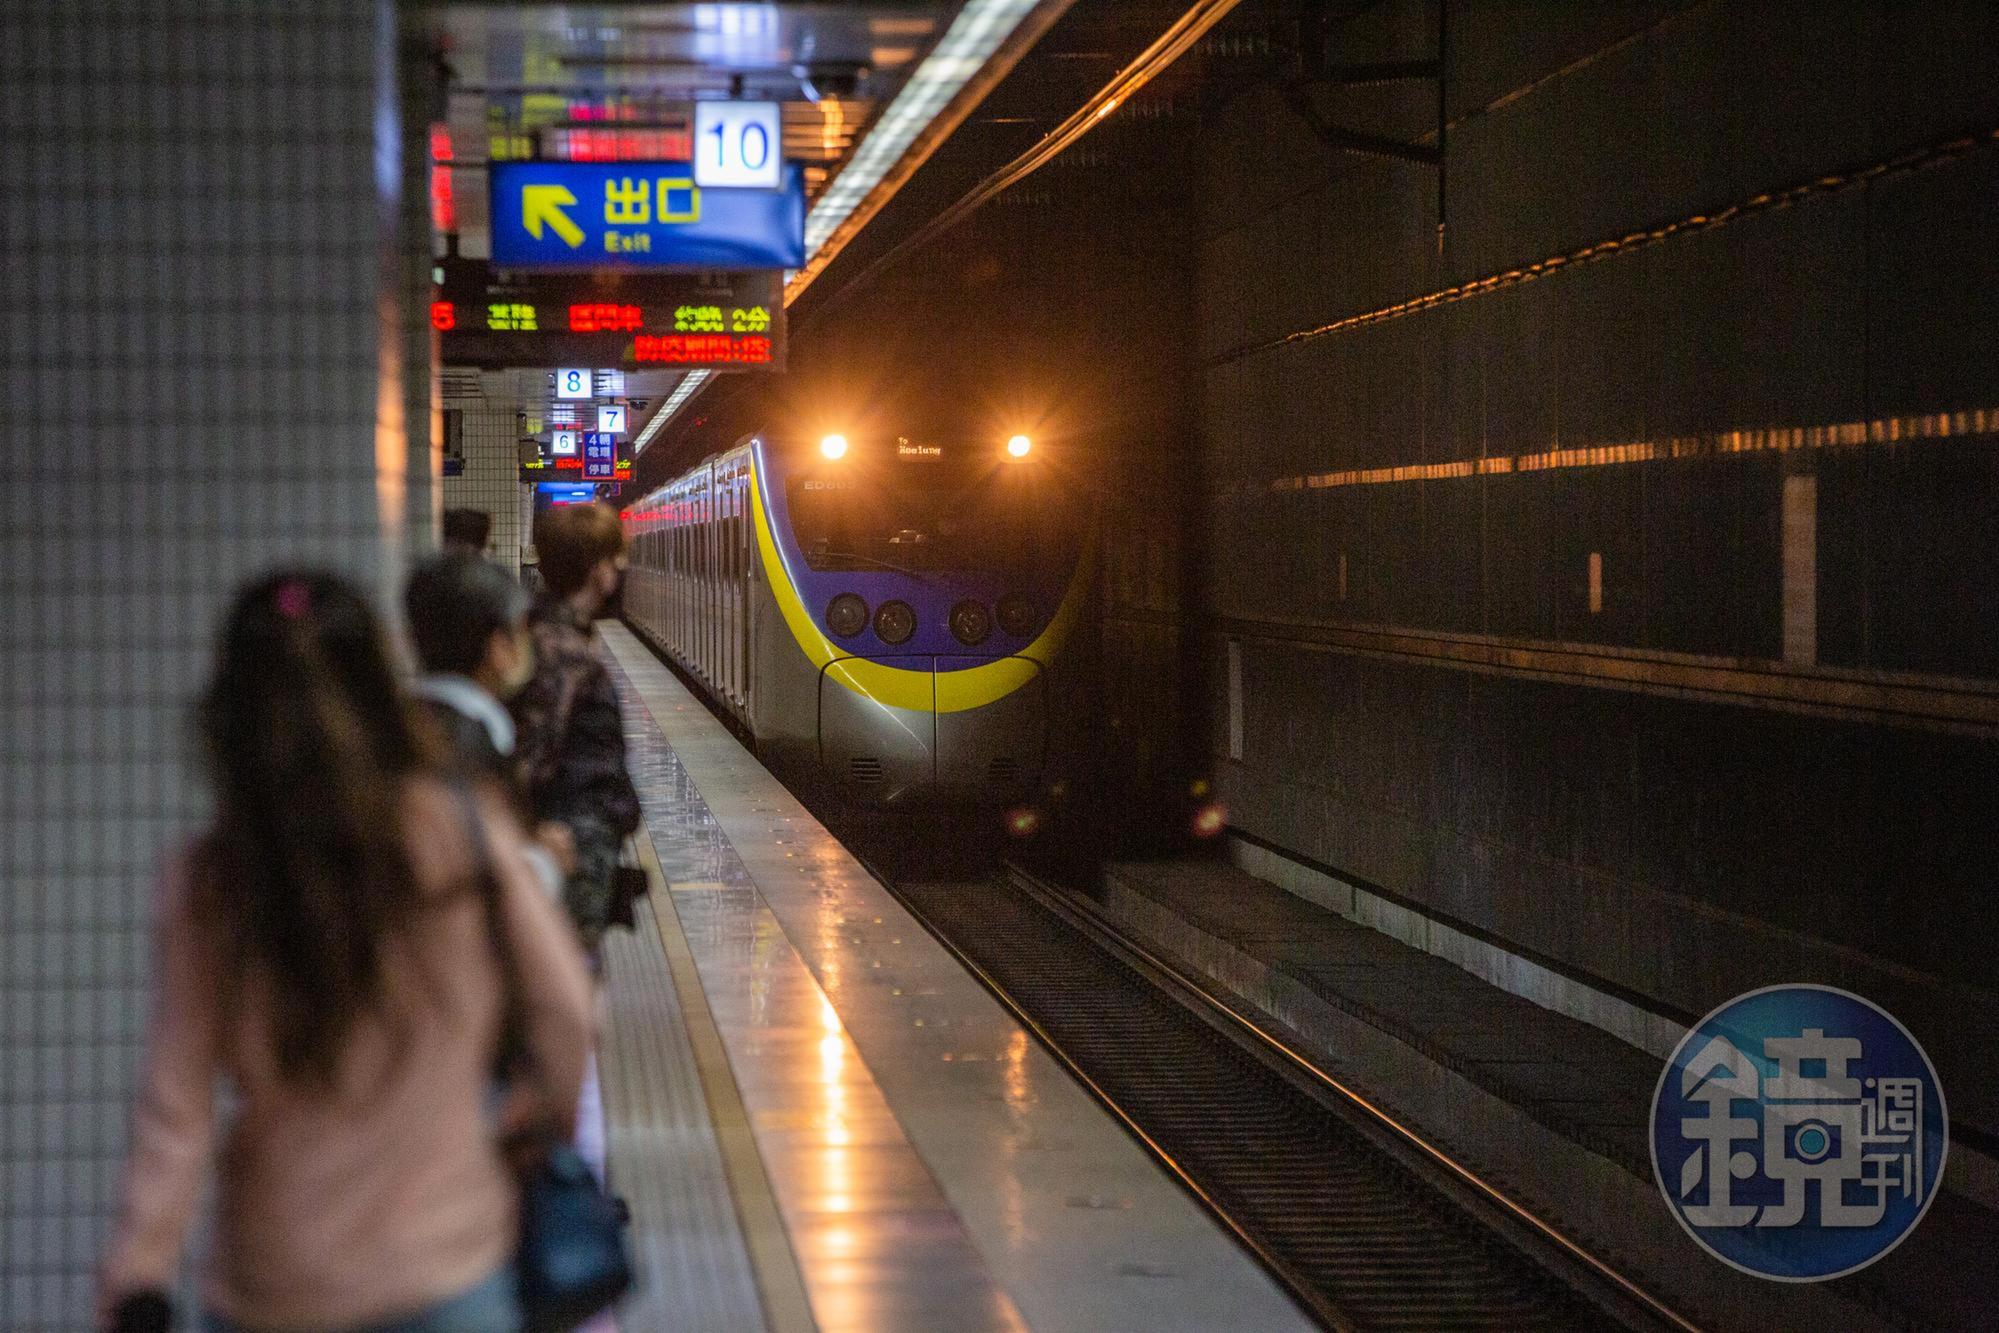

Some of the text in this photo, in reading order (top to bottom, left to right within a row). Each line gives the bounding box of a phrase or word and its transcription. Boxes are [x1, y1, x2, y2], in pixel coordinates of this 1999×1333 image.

[708, 120, 769, 170] 10
[604, 177, 701, 224] 出口
[604, 231, 651, 252] Exit
[567, 370, 581, 392] 8
[606, 411, 618, 427] 7
[559, 434, 569, 449] 6
[588, 464, 610, 475] 停車
